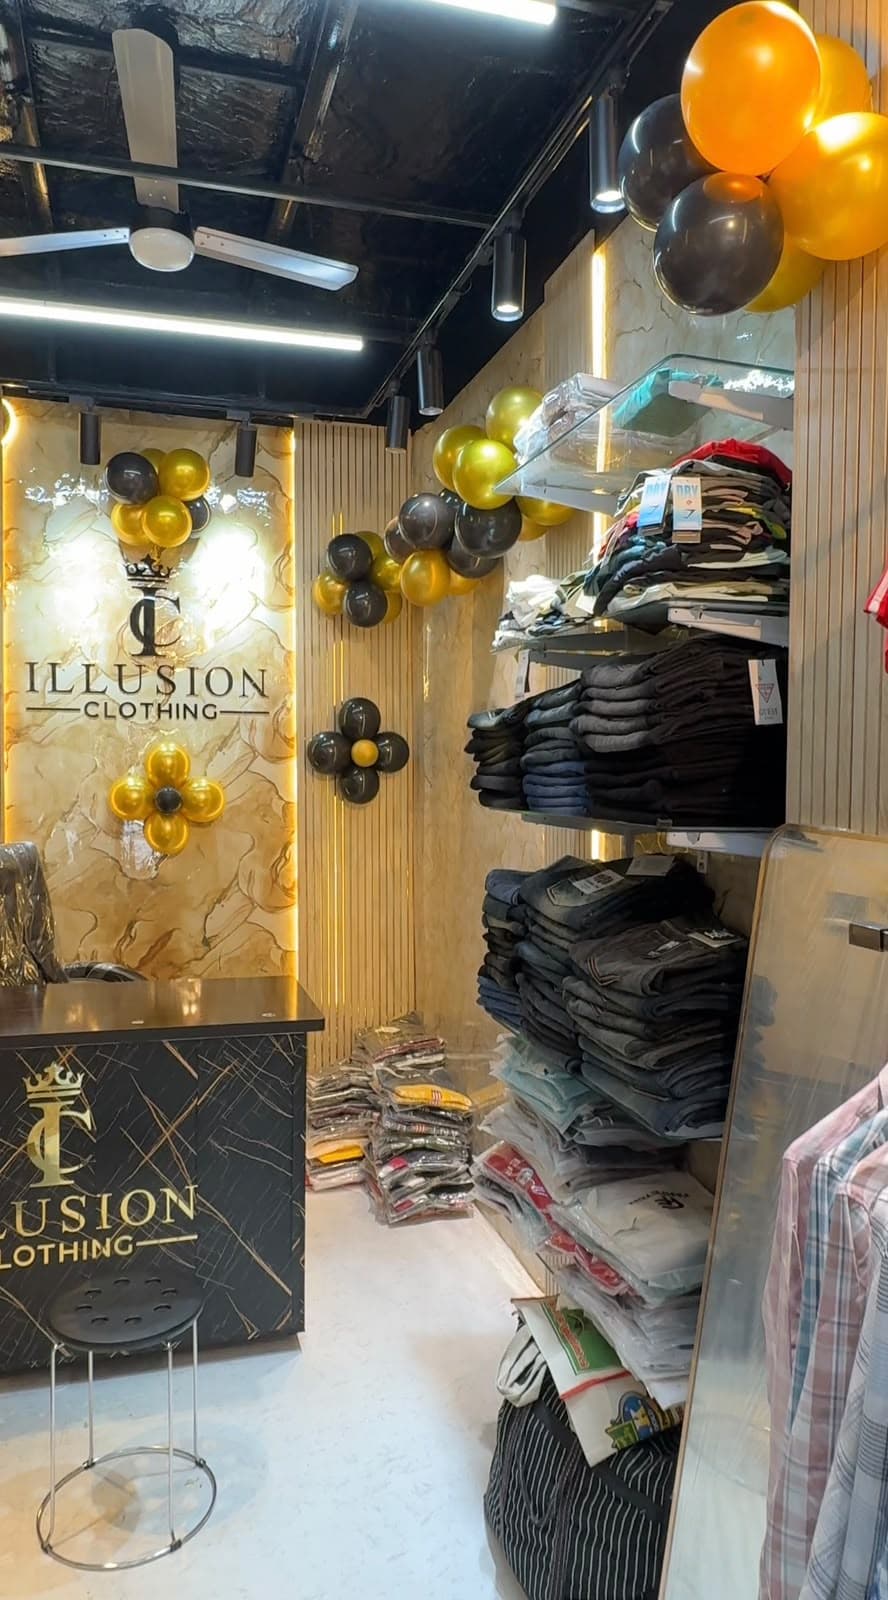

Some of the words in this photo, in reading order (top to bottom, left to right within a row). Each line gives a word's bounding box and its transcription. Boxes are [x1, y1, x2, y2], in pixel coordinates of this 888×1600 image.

[25, 661, 269, 698] ILLUSION
[83, 701, 218, 720] CLOTHING
[0, 1184, 199, 1240] USION
